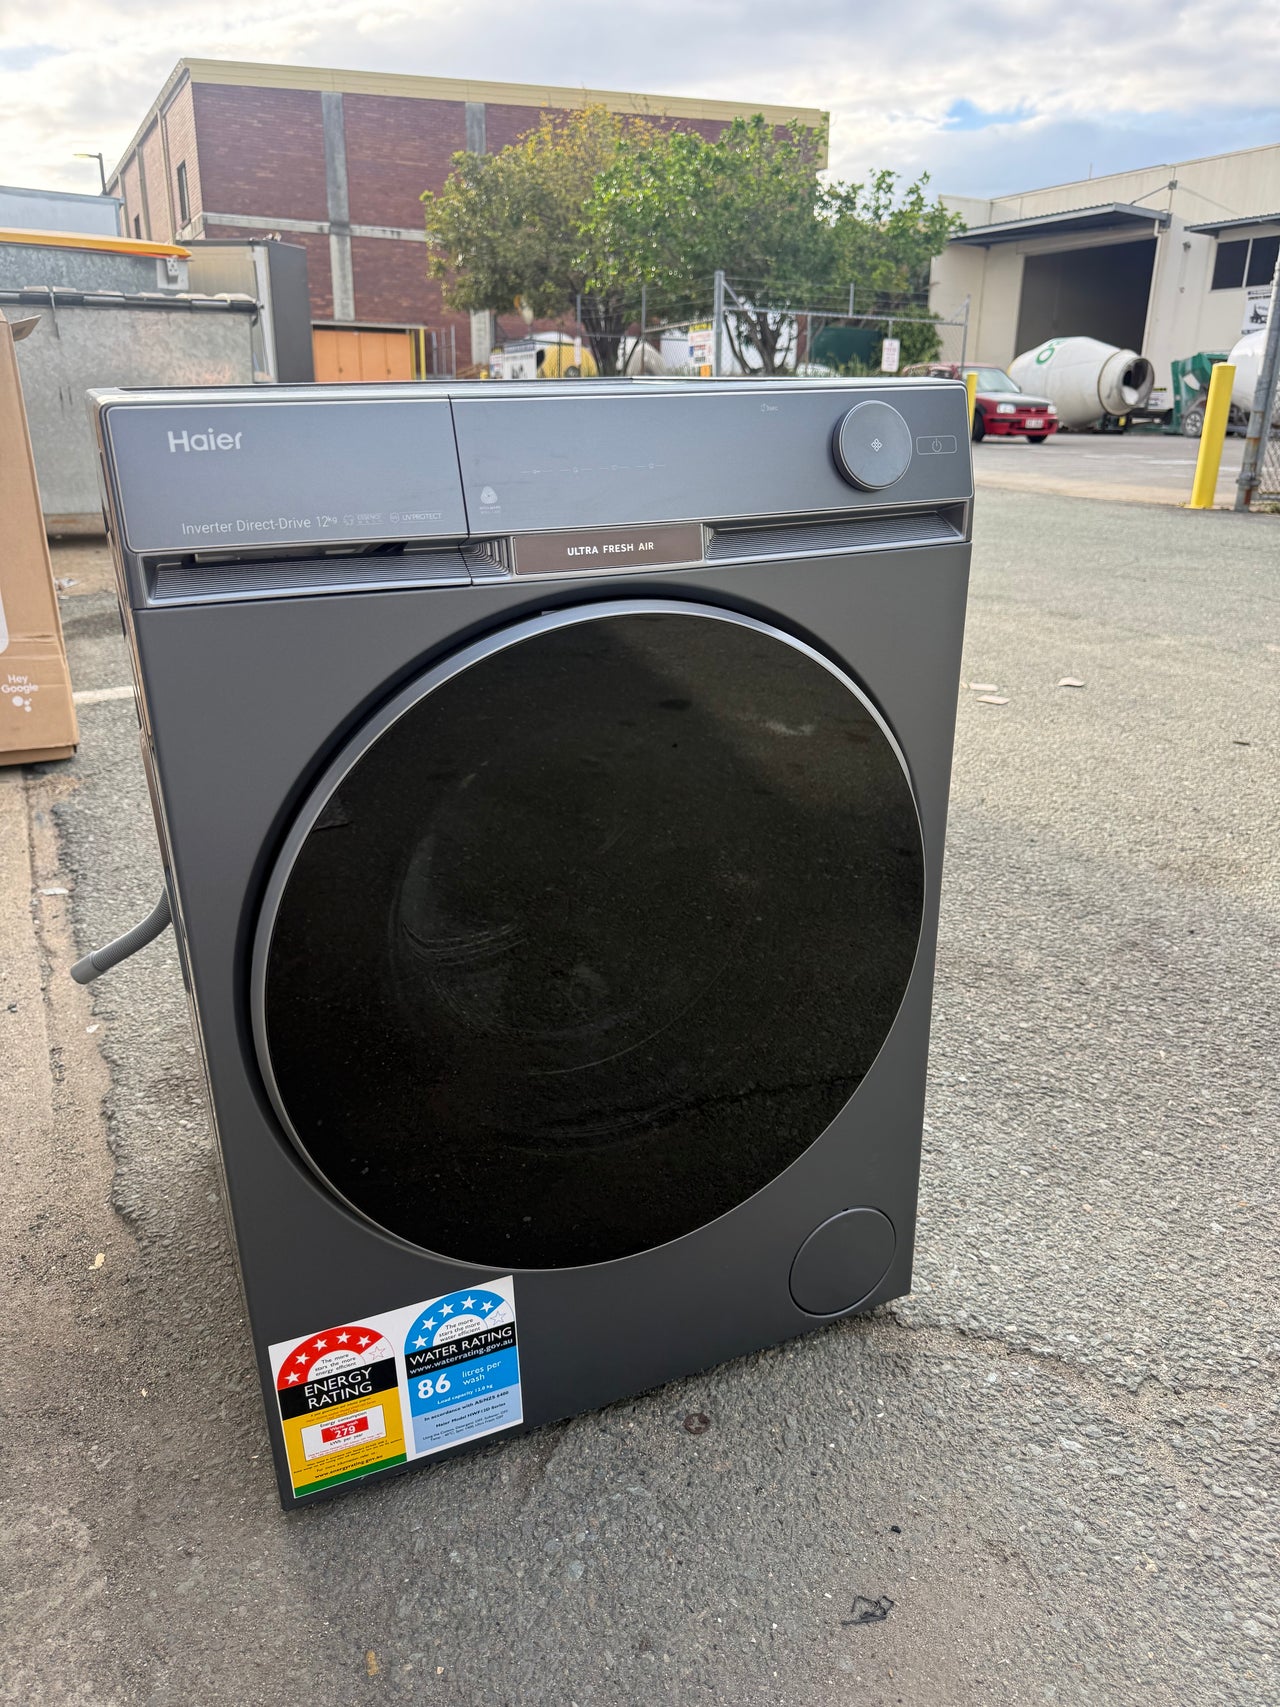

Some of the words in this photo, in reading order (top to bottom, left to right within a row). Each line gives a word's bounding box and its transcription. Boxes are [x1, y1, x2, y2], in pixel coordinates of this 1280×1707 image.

[167, 427, 243, 452] Haier
[182, 521, 233, 535] Inverter
[237, 517, 311, 533] Direct-Drive
[567, 546, 598, 556] ULTRA
[603, 544, 634, 553] FRESH
[638, 542, 654, 551] AIR
[8, 674, 28, 685] Hey
[1, 682, 39, 694] Google
[458, 1327, 480, 1337] efficient
[410, 1345, 458, 1365] WATER
[462, 1327, 512, 1350] RATING
[410, 1339, 513, 1374] www.waterrating.gov.au
[315, 1368, 333, 1376] energy
[336, 1362, 356, 1370] efficient
[304, 1367, 371, 1397] ENERGY
[417, 1373, 451, 1399] 86
[462, 1367, 484, 1377] litres
[487, 1361, 501, 1371] per
[463, 1374, 485, 1385] wash
[308, 1381, 372, 1409] RATING
[450, 1391, 473, 1400] capacity
[338, 1412, 367, 1423] consumption
[431, 1408, 460, 1419] accordance
[335, 1425, 356, 1438] 279
[315, 1455, 383, 1478] www.energyrating.gov.au
